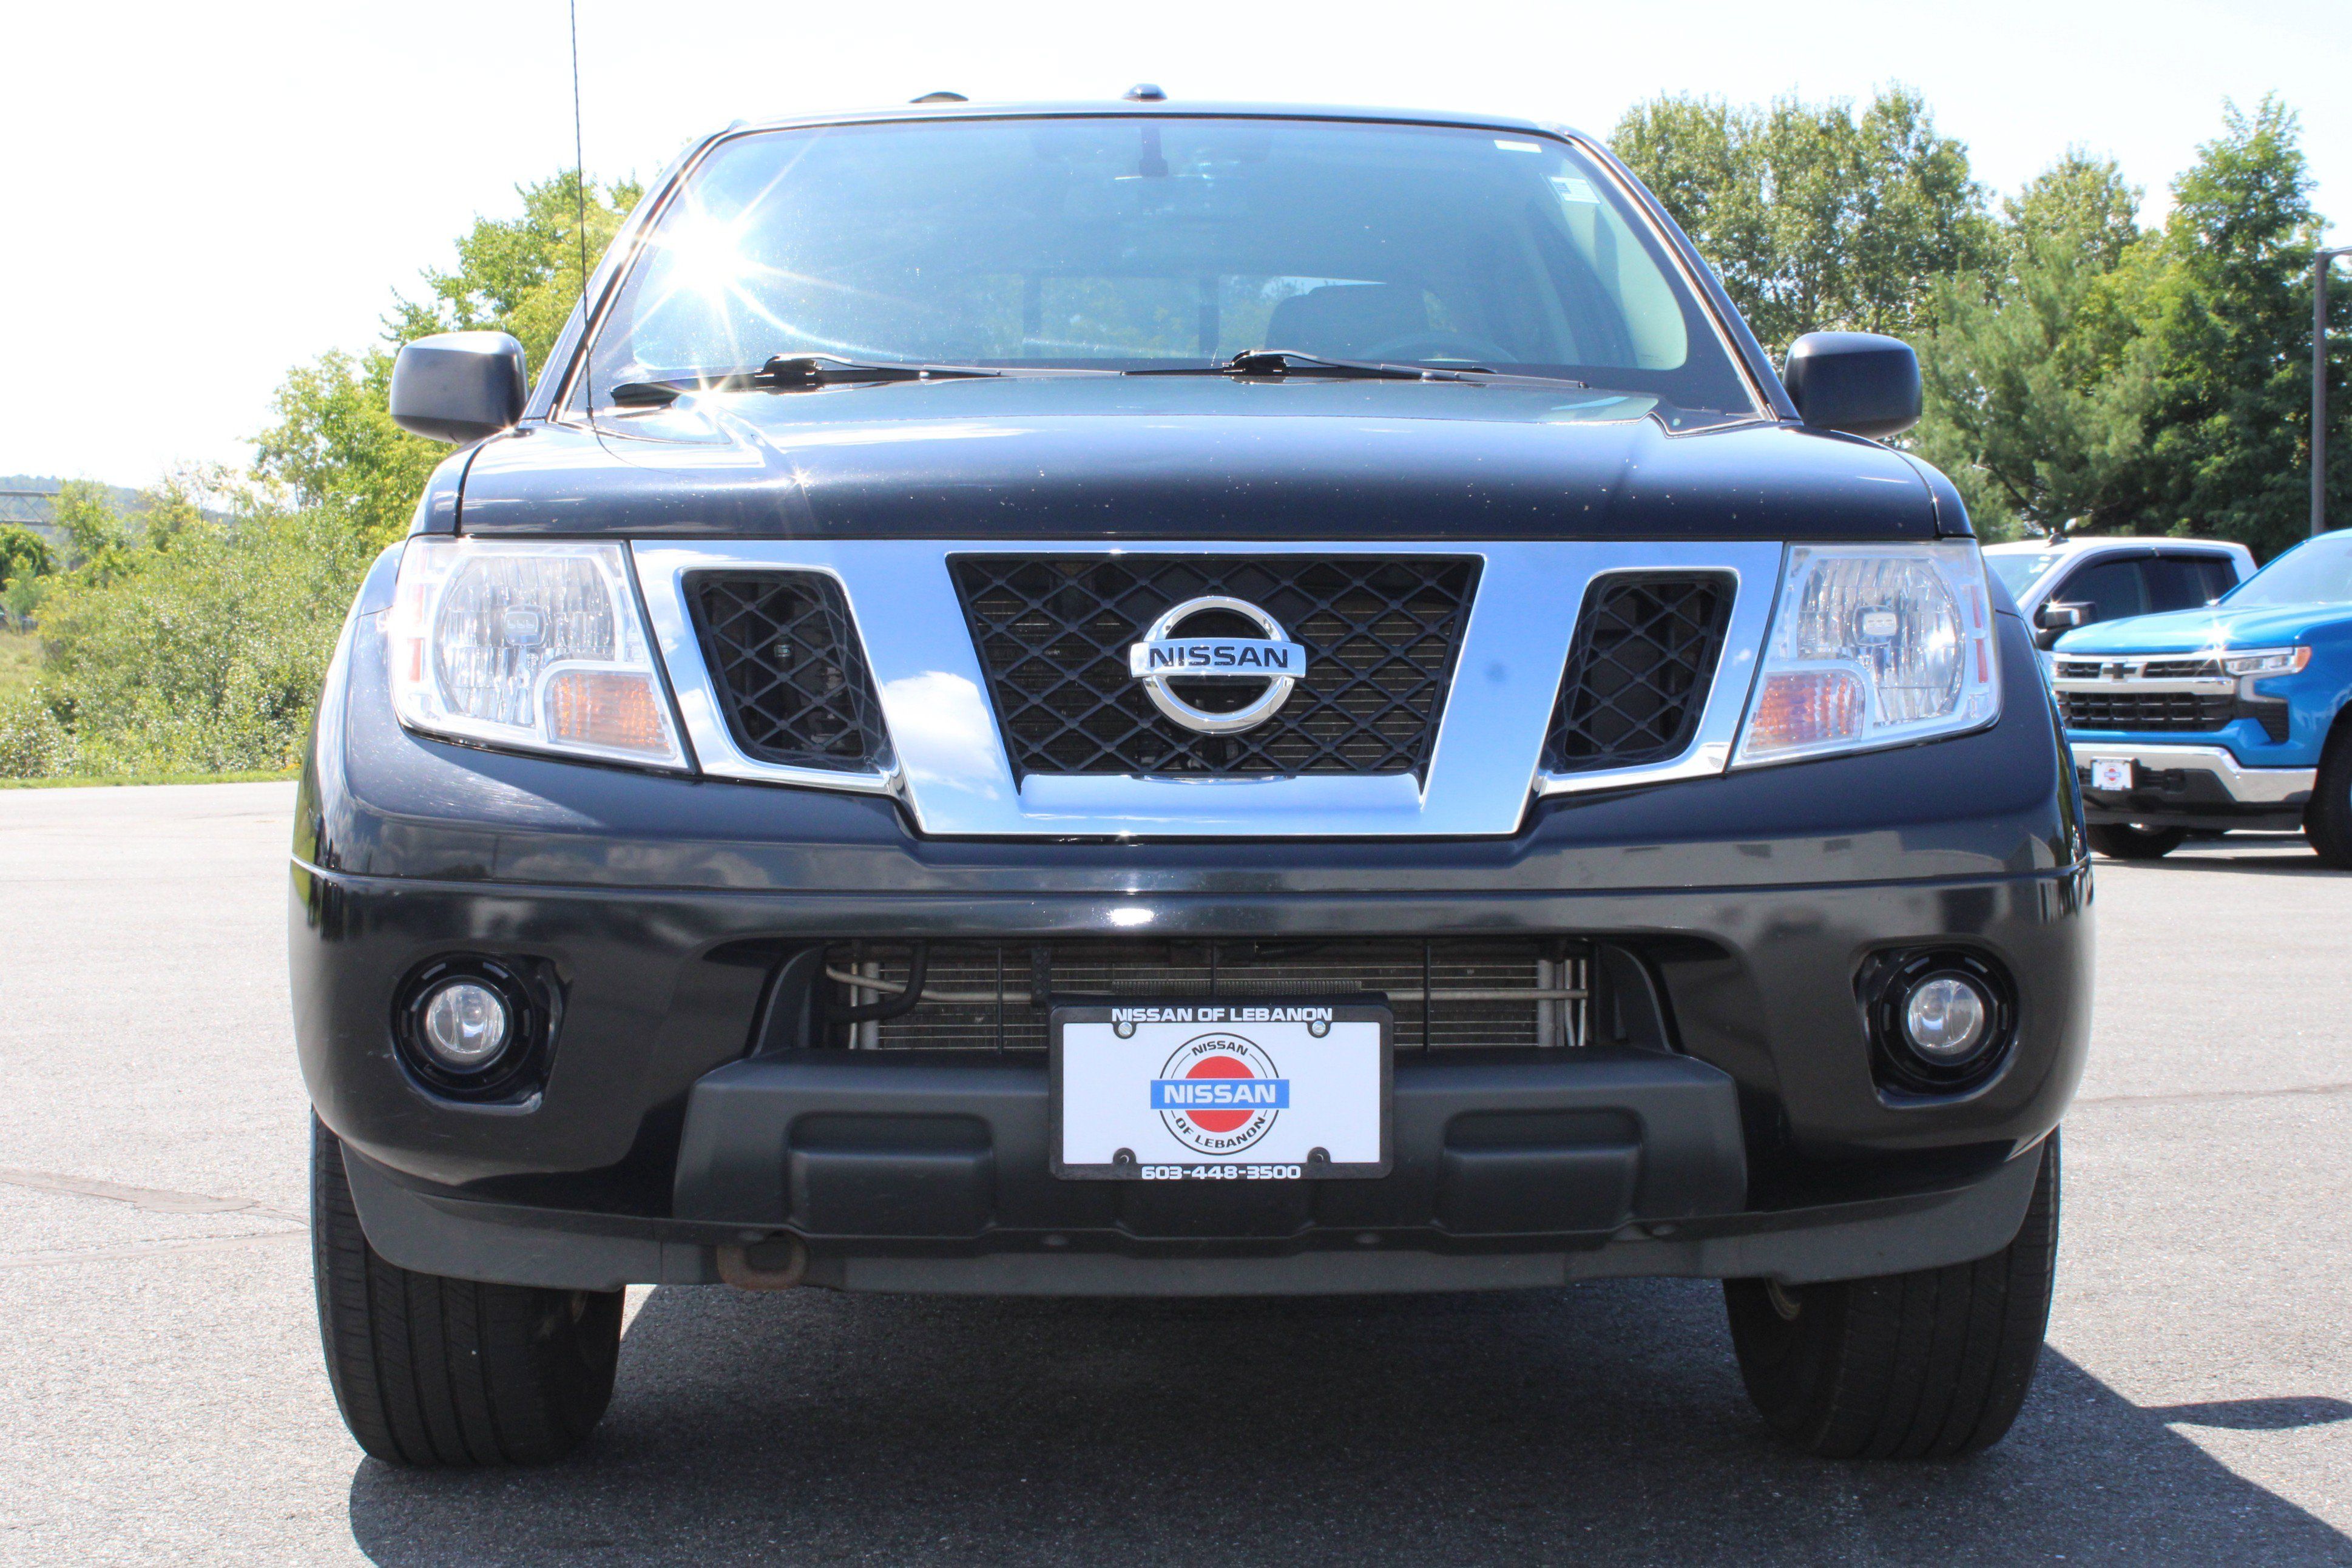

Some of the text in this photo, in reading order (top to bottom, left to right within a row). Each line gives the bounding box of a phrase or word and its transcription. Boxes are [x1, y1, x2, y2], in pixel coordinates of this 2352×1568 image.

[1149, 646, 1288, 668] NISSAN
[1112, 1008, 1332, 1022] NISSAN OF LEBANON
[1191, 1041, 1248, 1056] NISSAN
[1164, 1084, 1276, 1103] NISSAN
[1175, 1116, 1266, 1149] OF LEBANON
[1141, 1165, 1301, 1180] 603-448-3500
